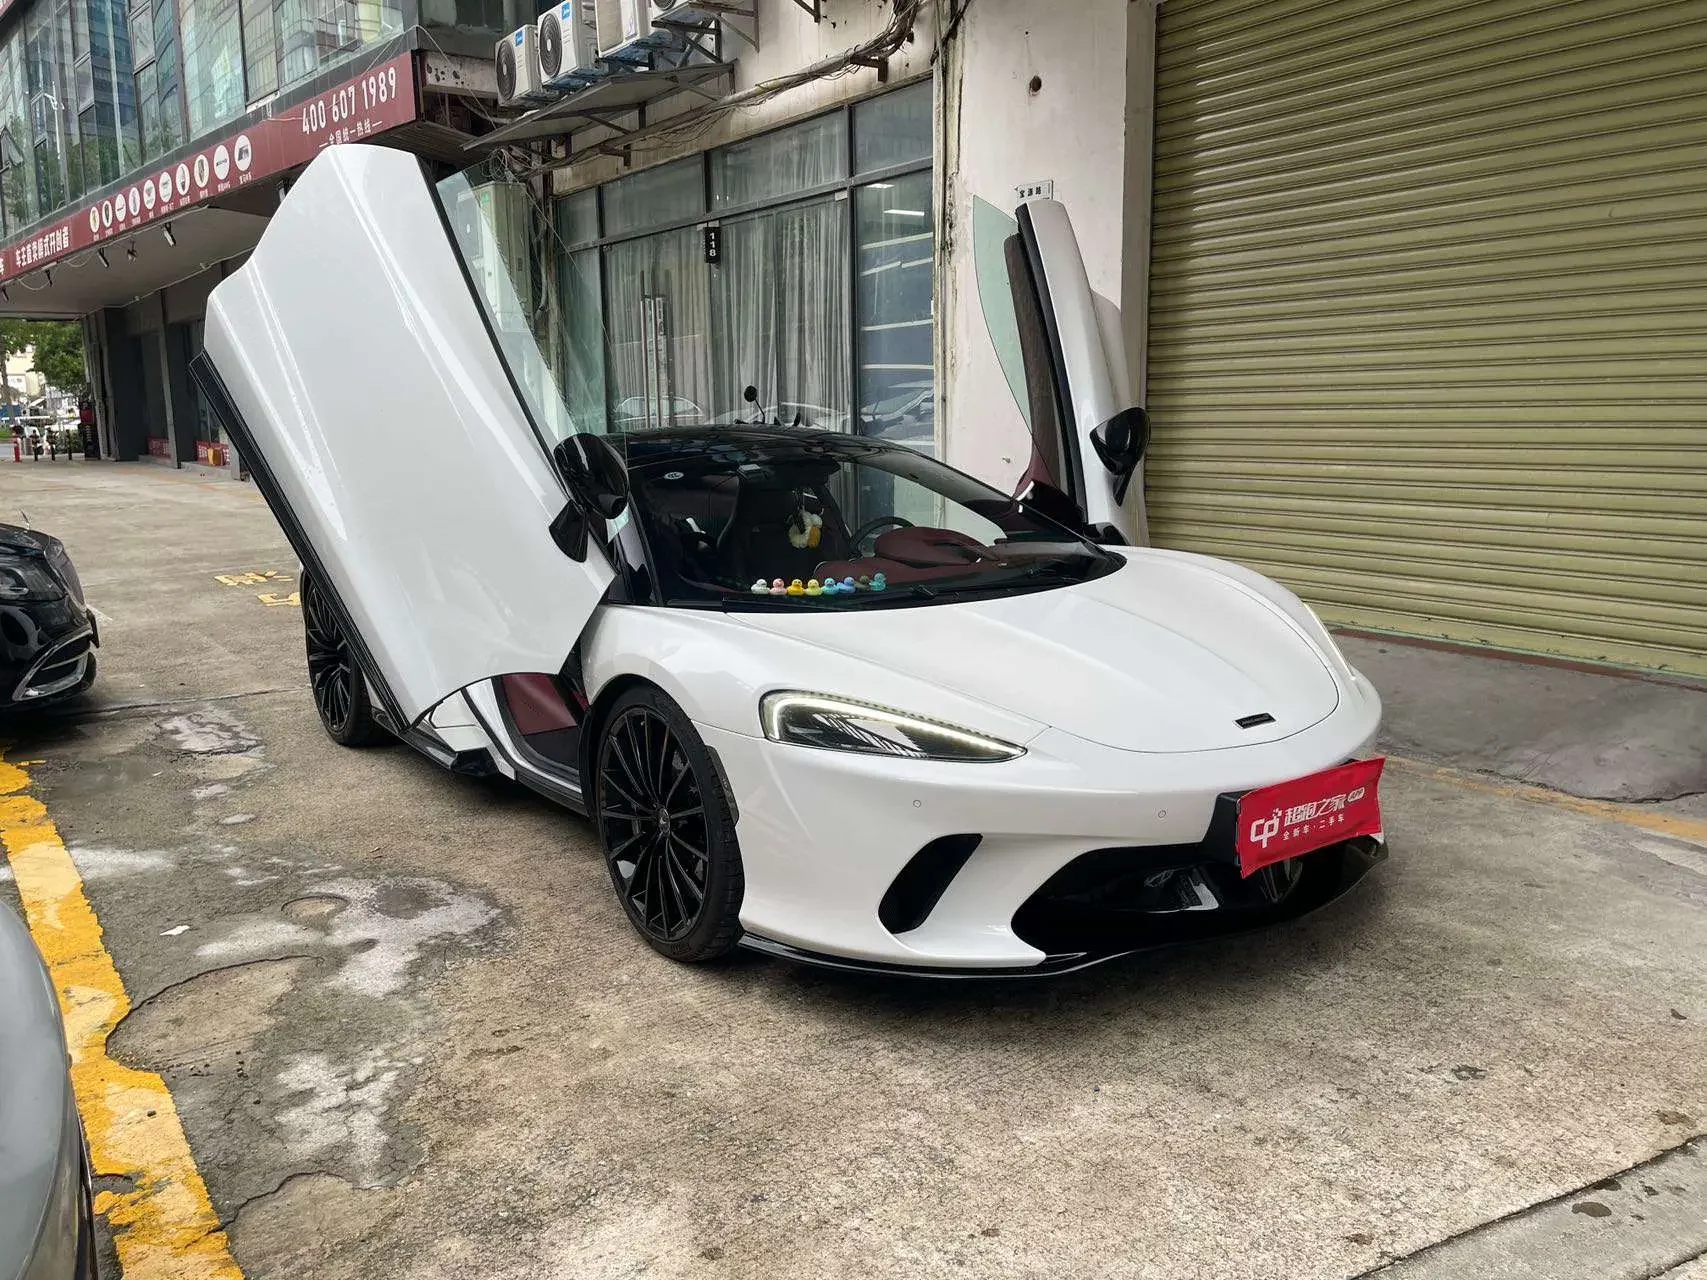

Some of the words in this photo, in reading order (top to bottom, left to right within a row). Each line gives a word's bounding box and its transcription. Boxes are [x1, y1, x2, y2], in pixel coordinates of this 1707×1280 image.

[302, 100, 327, 135] 400
[332, 85, 355, 122] 607
[361, 67, 396, 110] 1989
[329, 118, 372, 145] 全国统一热线
[708, 231, 717, 257] 118
